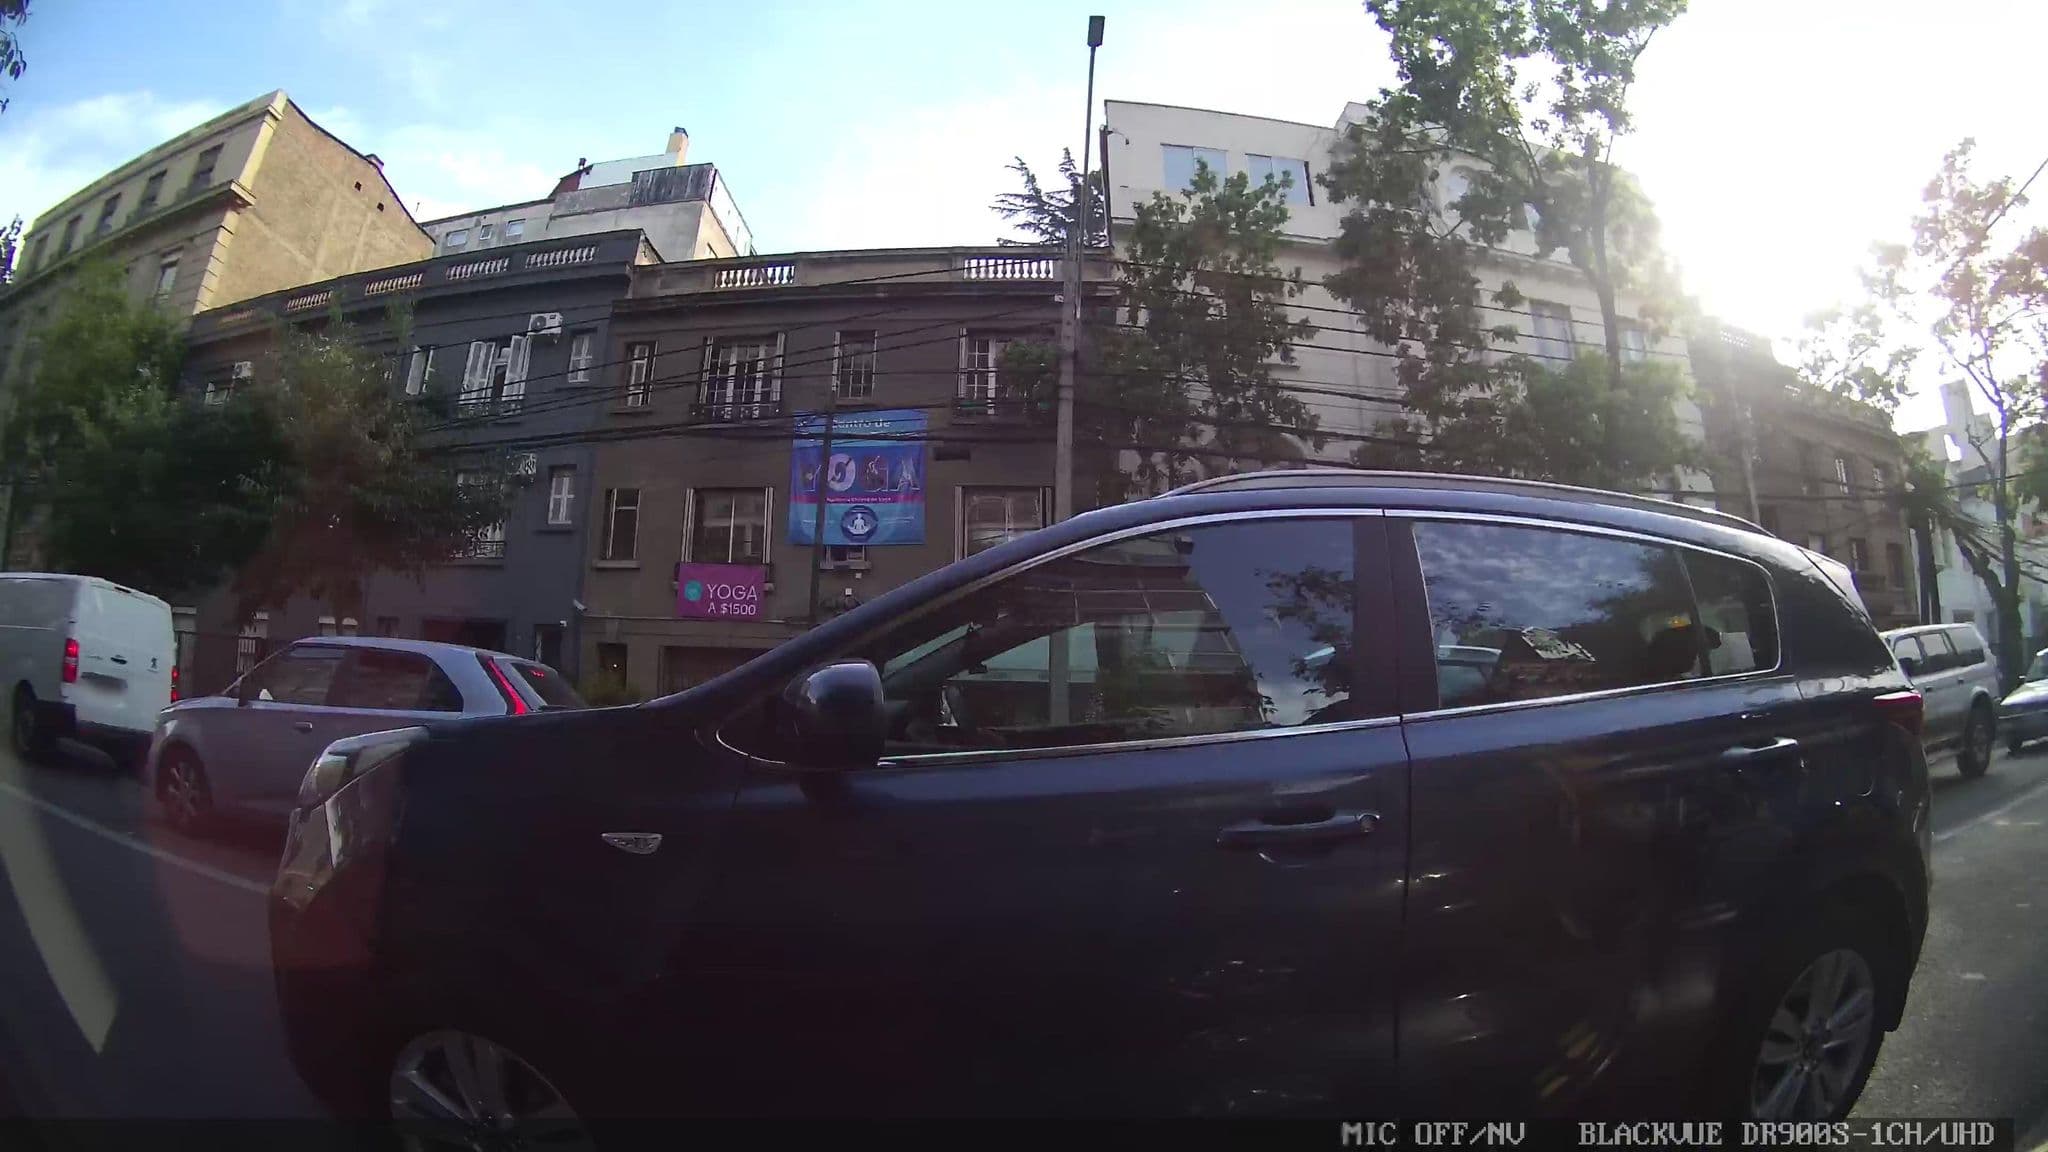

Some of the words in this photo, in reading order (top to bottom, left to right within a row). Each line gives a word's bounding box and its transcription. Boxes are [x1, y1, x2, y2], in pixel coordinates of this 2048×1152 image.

[875, 418, 891, 428] de
[706, 583, 758, 601] YOGA
[707, 602, 717, 614] A
[720, 602, 757, 615] $1500
